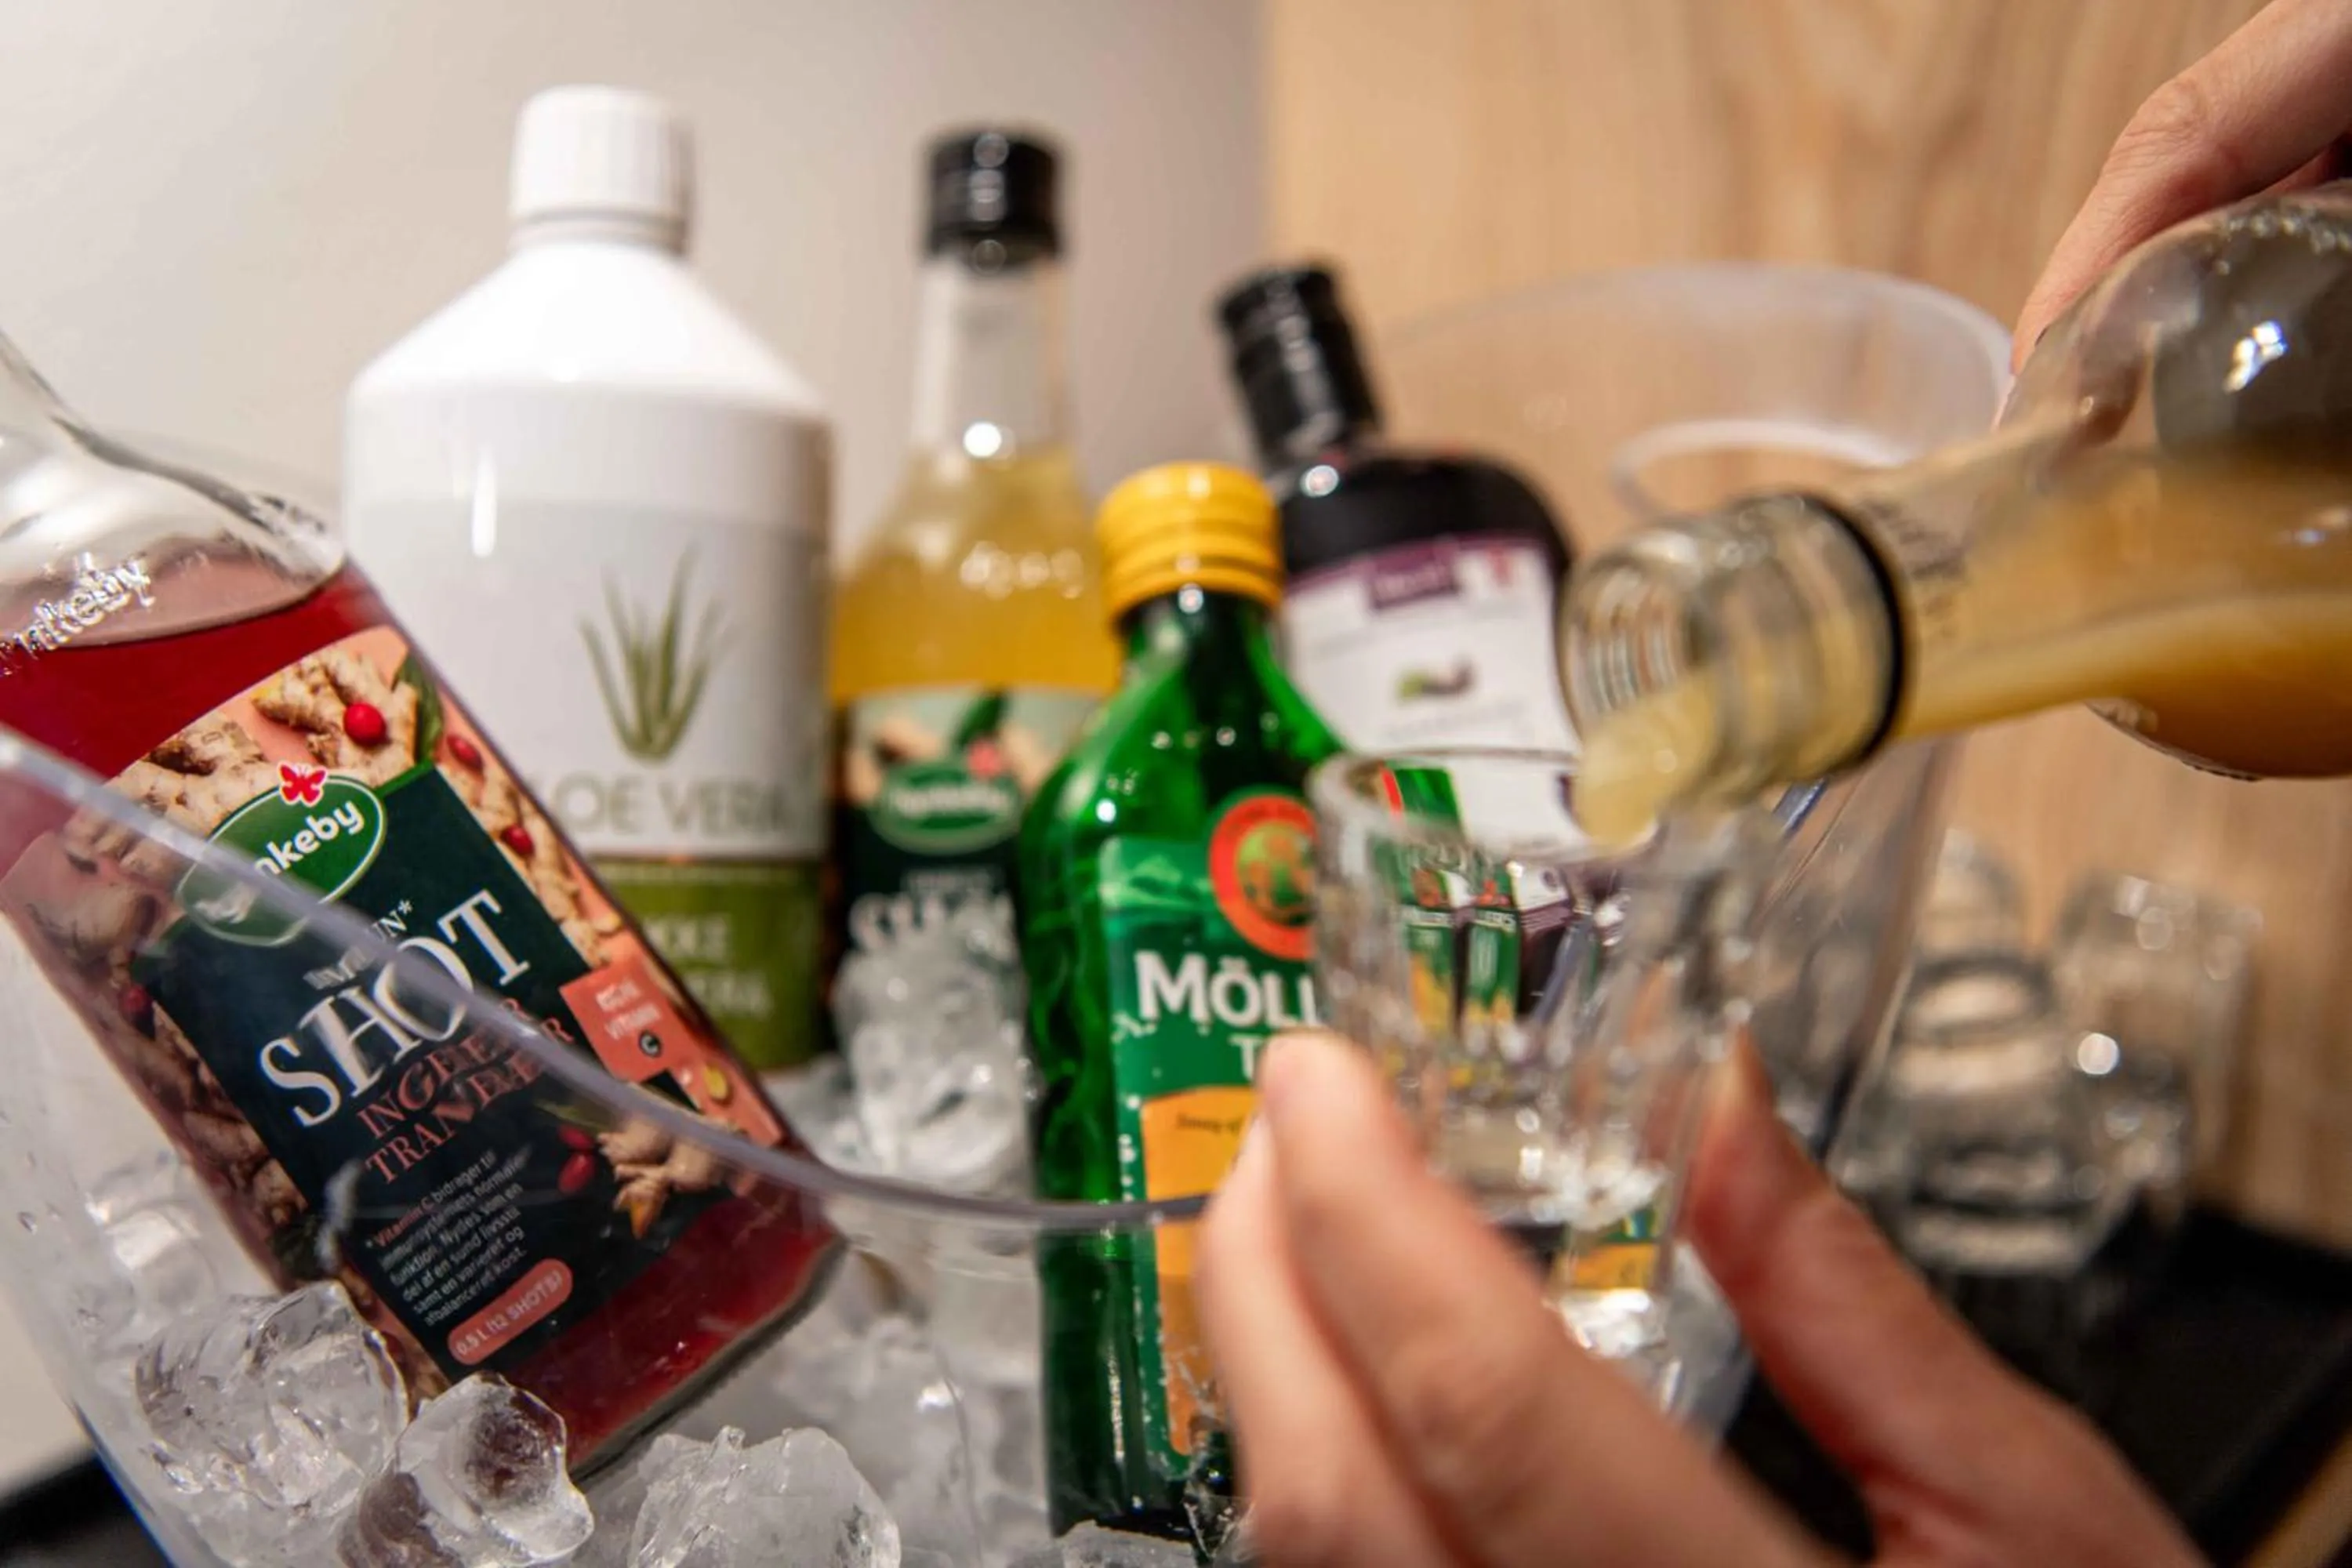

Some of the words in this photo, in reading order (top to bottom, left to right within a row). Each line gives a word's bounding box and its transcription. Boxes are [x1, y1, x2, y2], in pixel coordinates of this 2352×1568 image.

[261, 889, 530, 1127] SHOT
[1134, 949, 1320, 1029] MÖLL
[503, 1224, 526, 1247] og
